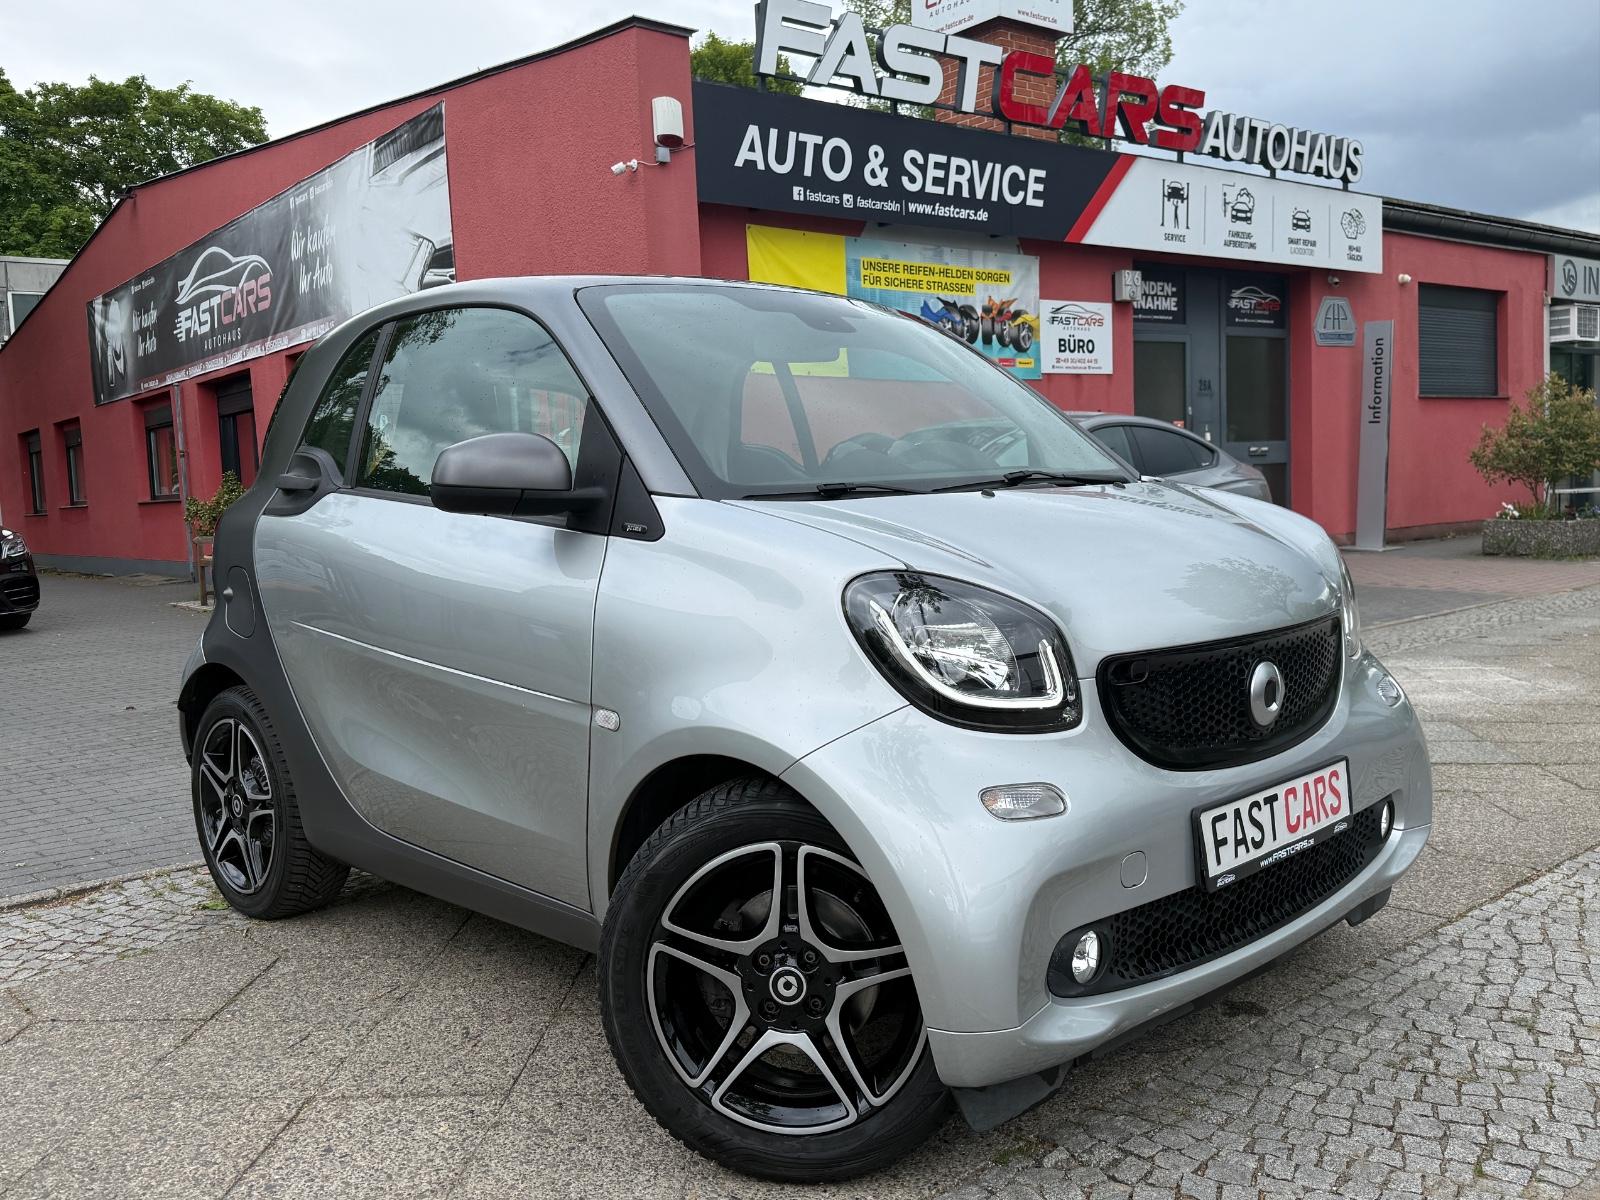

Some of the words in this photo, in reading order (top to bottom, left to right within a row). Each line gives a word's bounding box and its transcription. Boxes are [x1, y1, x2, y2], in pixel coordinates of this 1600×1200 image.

[1017, 8, 1058, 25] www.fastcars.de
[1202, 110, 1365, 184] AUTOHAUS
[734, 124, 853, 182] AUTO
[863, 144, 889, 188] &
[901, 149, 1047, 208] SERVICE
[806, 189, 840, 206] fastcars
[856, 195, 901, 213] fastcarsbln
[908, 201, 989, 222] www.fastcars.de
[290, 229, 306, 262] Wir
[307, 213, 337, 256] kaufen
[1164, 232, 1186, 243] SERVICE
[313, 254, 333, 290] Auto
[862, 260, 900, 274] UNSERE
[902, 264, 974, 281] REIFEN-HELDEN
[975, 271, 1010, 284] SORGEN
[863, 273, 882, 286] FÜR
[884, 278, 924, 290] SICHERE
[925, 282, 974, 294] STRASSEN!
[1141, 281, 1177, 296] NDEN-
[177, 272, 272, 343] FASTCARS
[1050, 315, 1105, 328] FASTCARS
[204, 327, 241, 352] AUTOHAUS
[1058, 334, 1095, 354] BÜRO
[1368, 337, 1384, 424] Information
